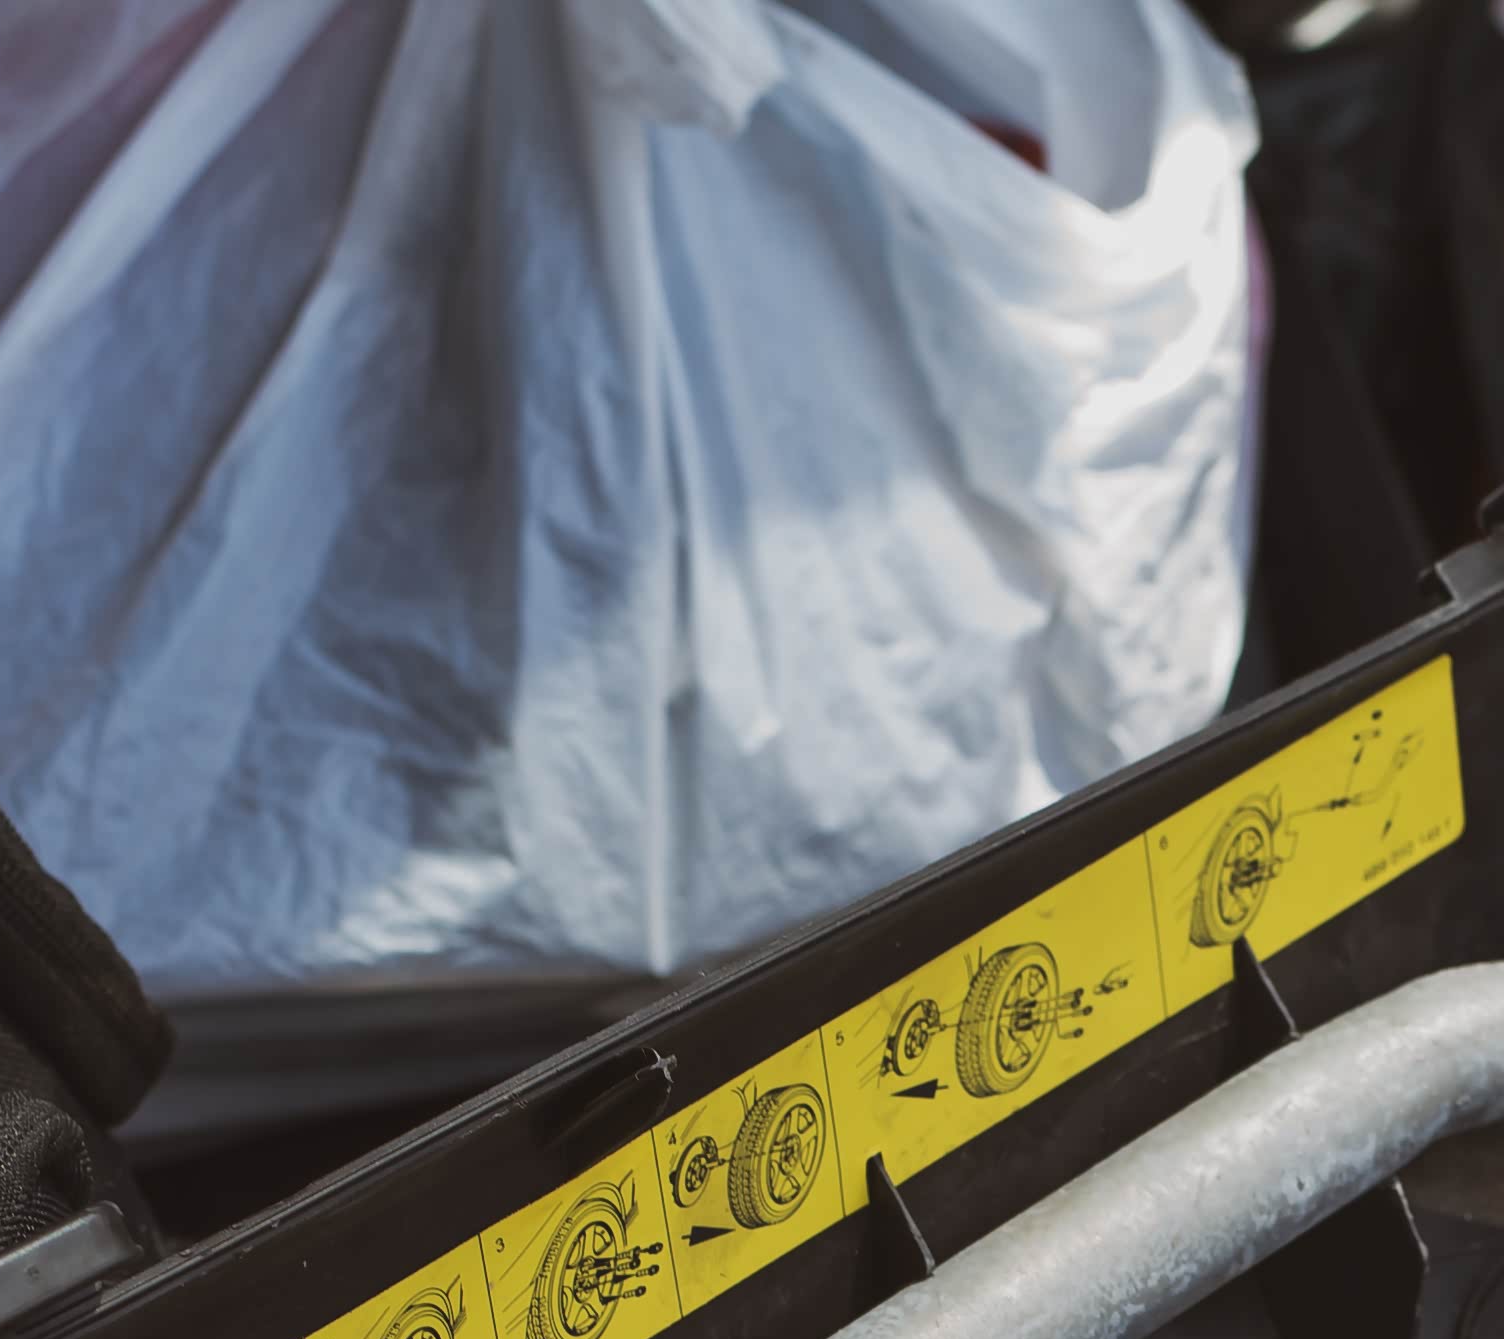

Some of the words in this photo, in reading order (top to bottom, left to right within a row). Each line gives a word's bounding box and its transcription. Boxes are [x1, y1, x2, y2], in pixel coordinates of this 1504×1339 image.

[1160, 836, 1168, 850] 6
[836, 1030, 844, 1046] 5
[668, 1132, 677, 1144] 4
[495, 1237, 505, 1252] 3
